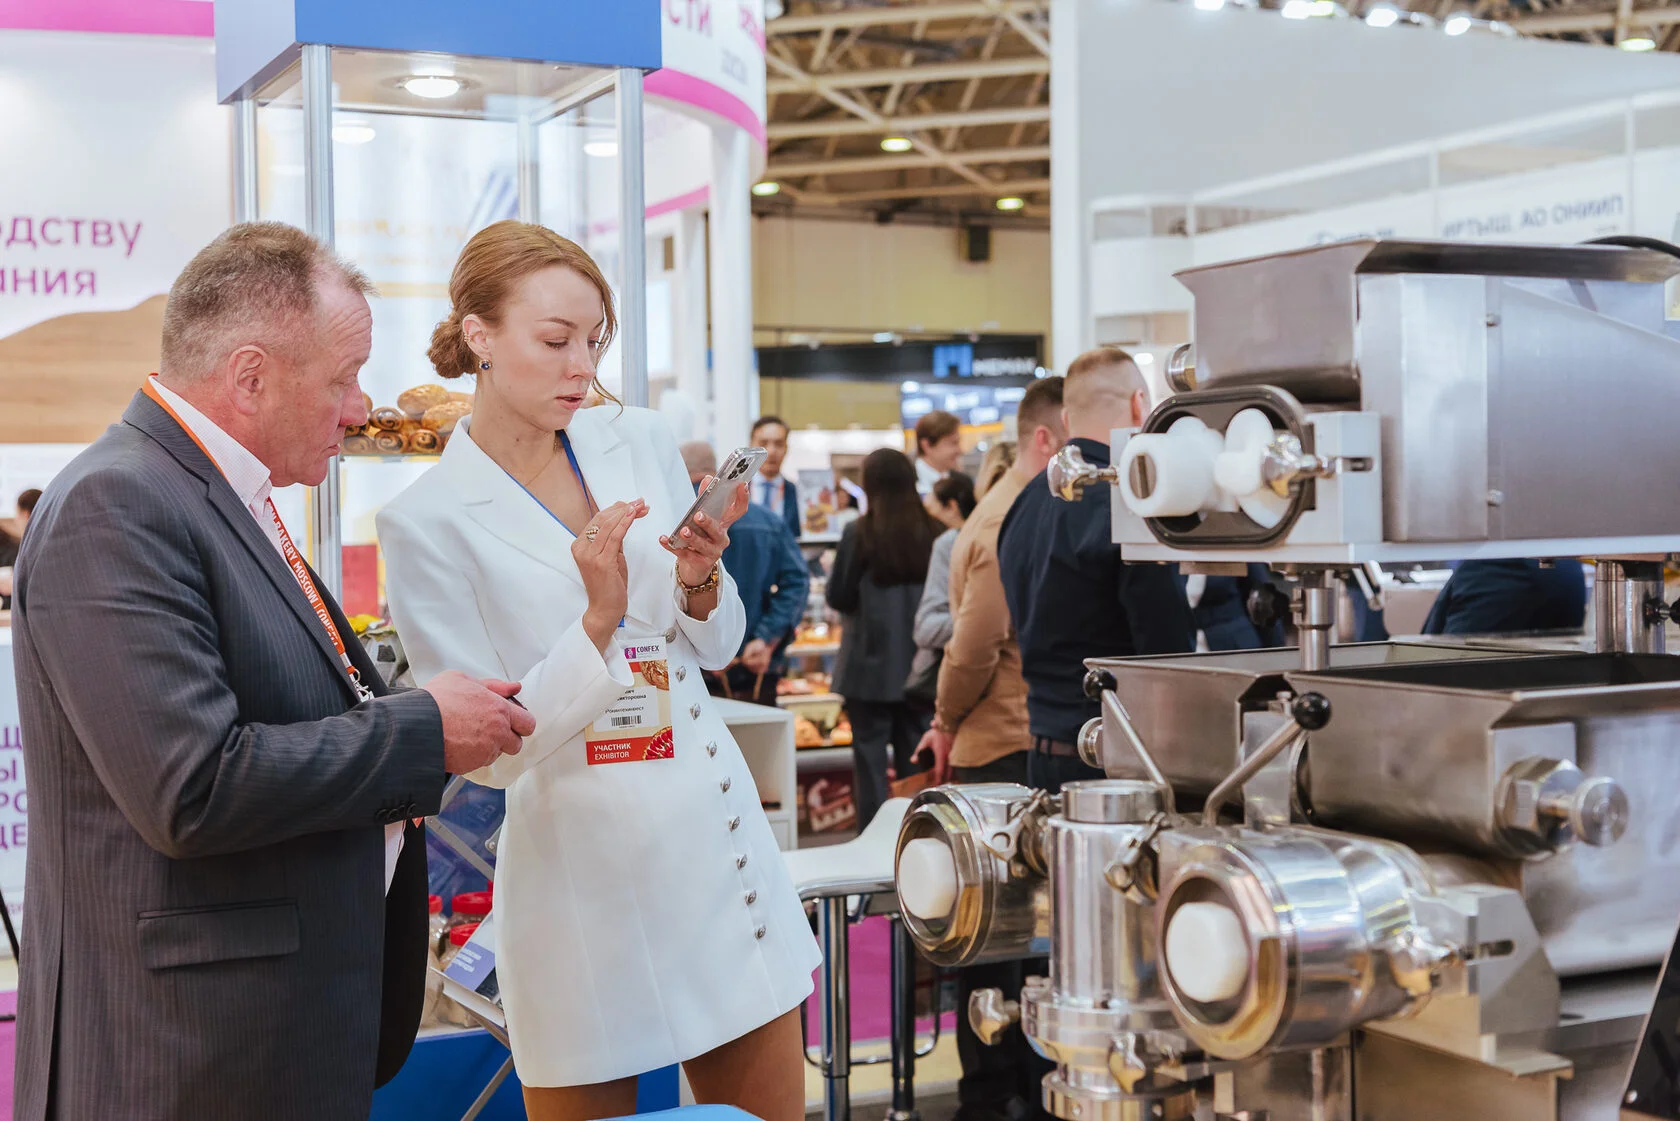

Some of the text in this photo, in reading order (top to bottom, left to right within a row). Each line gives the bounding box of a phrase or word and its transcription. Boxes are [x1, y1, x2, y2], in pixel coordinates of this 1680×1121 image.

[0, 217, 143, 259] дству
[293, 560, 320, 605] MOSCOW
[636, 645, 660, 653] CONFEX
[593, 742, 632, 752] УЧАСТНИК
[594, 751, 630, 761] EXHIBITOR
